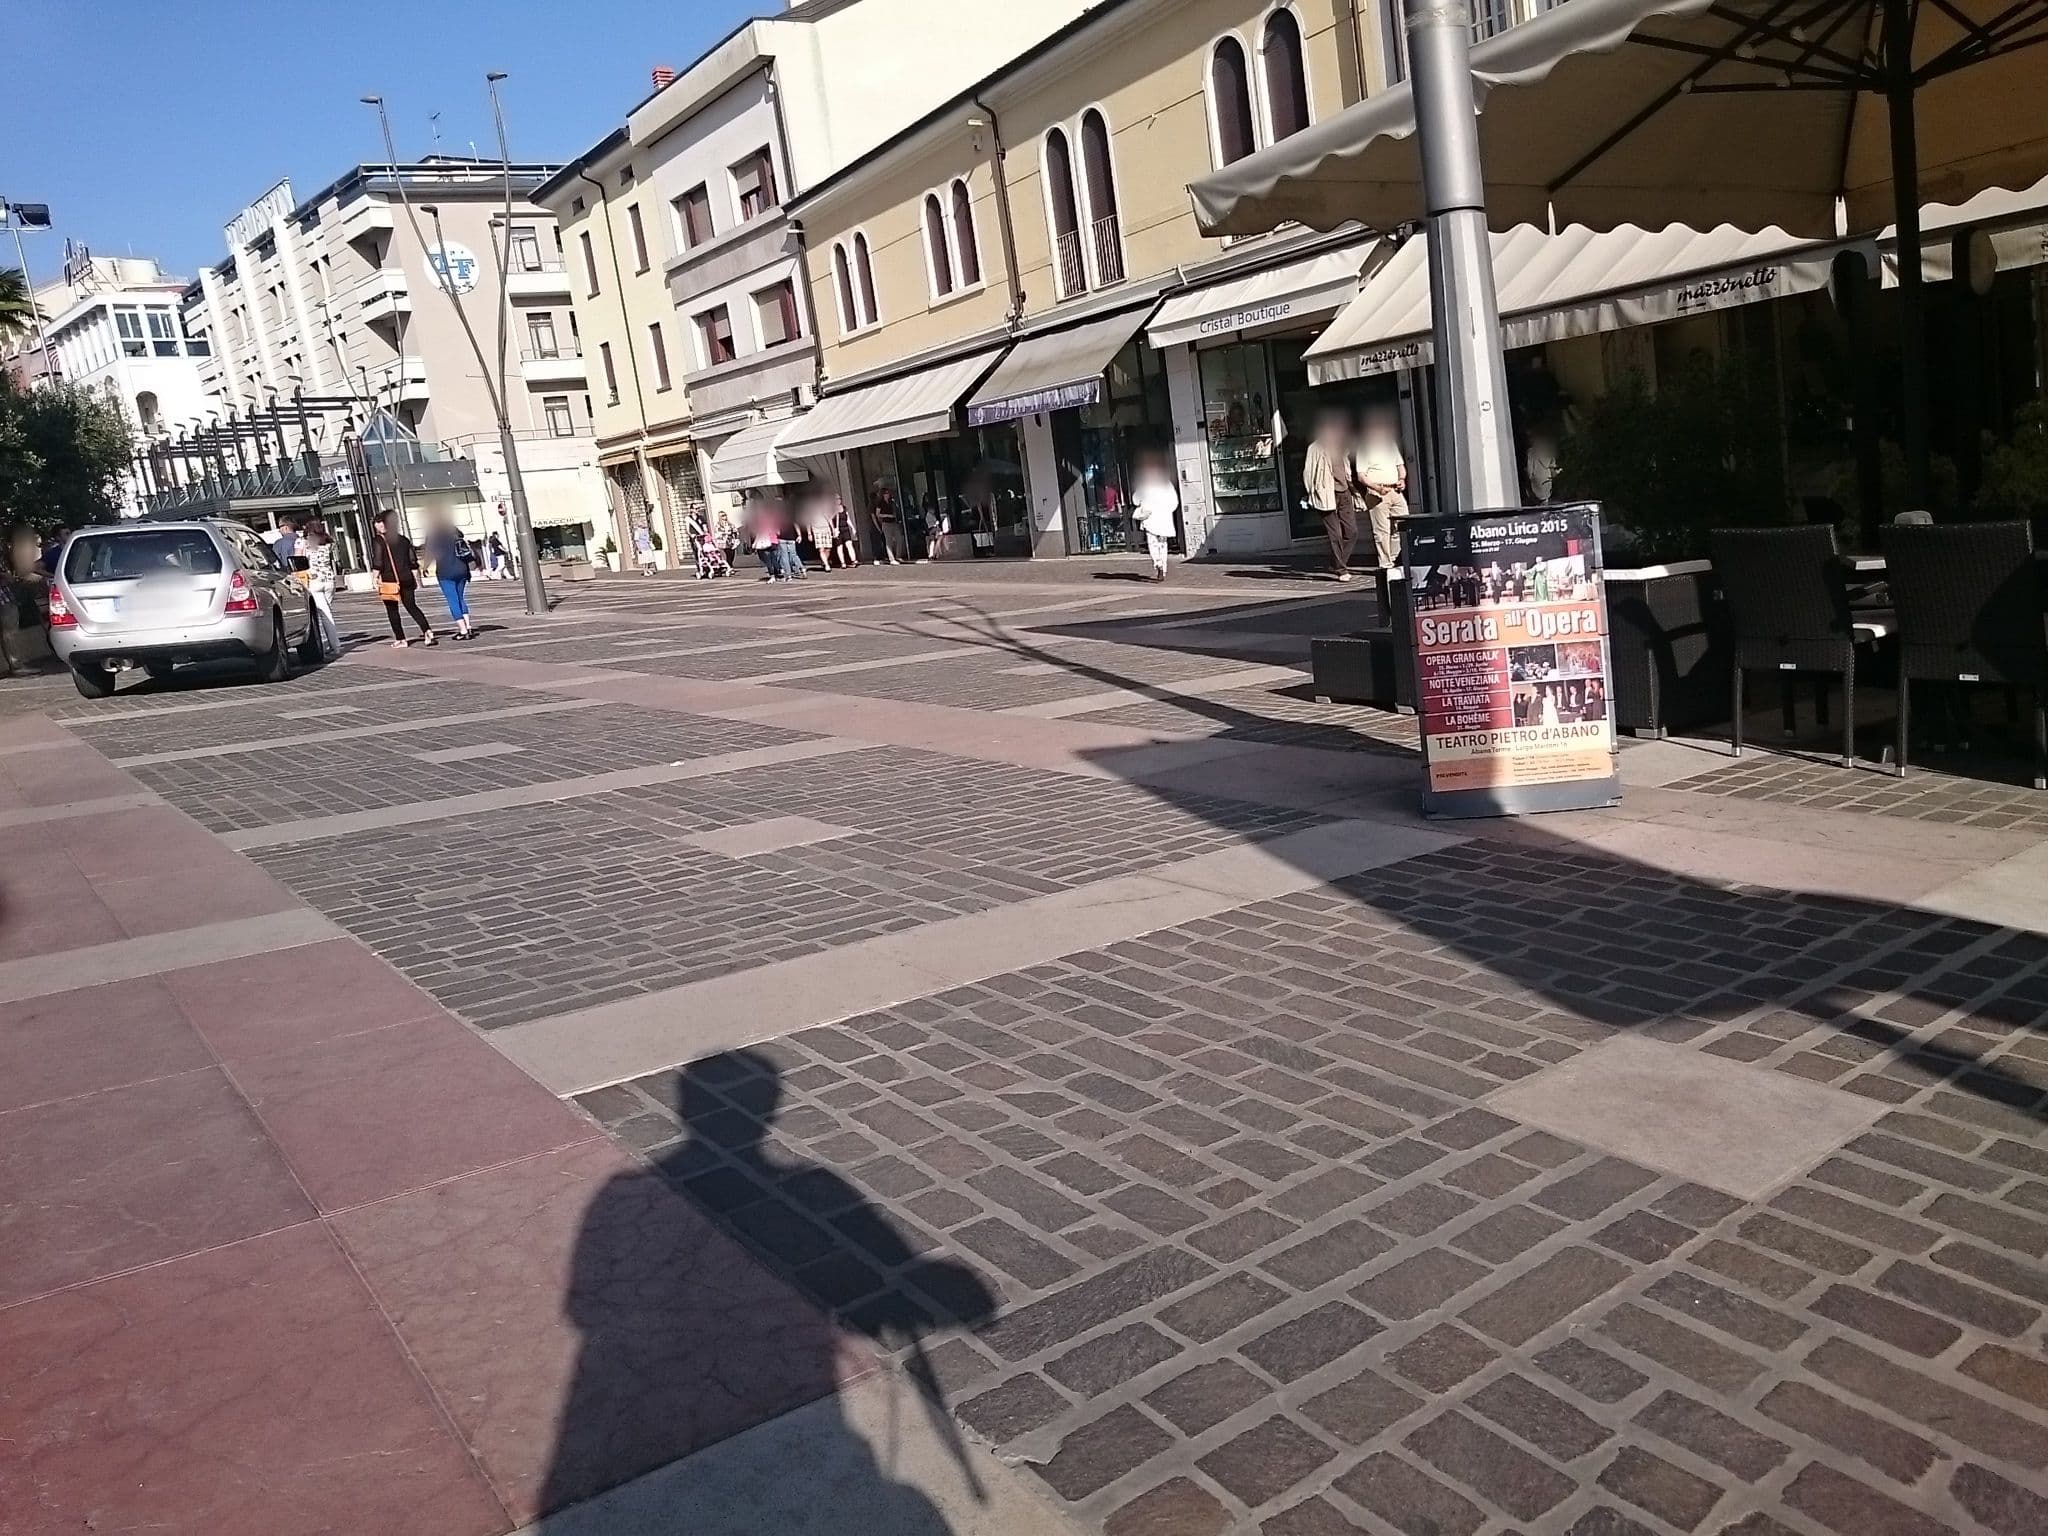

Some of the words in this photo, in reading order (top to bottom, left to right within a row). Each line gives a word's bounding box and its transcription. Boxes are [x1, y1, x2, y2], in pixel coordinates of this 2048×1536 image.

[1677, 267, 1777, 303] mazzonetto
[1200, 315, 1233, 333] Cristal
[1237, 304, 1290, 325] Boutique
[1470, 523, 1506, 539] Abano
[1508, 522, 1539, 537] Lirica
[1540, 519, 1568, 533] 2015
[1422, 614, 1499, 646] Serata
[1426, 655, 1452, 666] OPERA
[1452, 652, 1475, 663] GRAN
[1429, 677, 1455, 689] NOTTE
[1455, 674, 1500, 687] VENEZIANA
[1442, 697, 1452, 707] LA
[1452, 694, 1491, 706] TRAVIATA
[1445, 716, 1456, 726] LA
[1457, 712, 1491, 725] BOHÈME
[1436, 733, 1488, 749] TEATRO
[1491, 729, 1537, 745] PIETRO
[1542, 724, 1600, 740] d'ABANO
